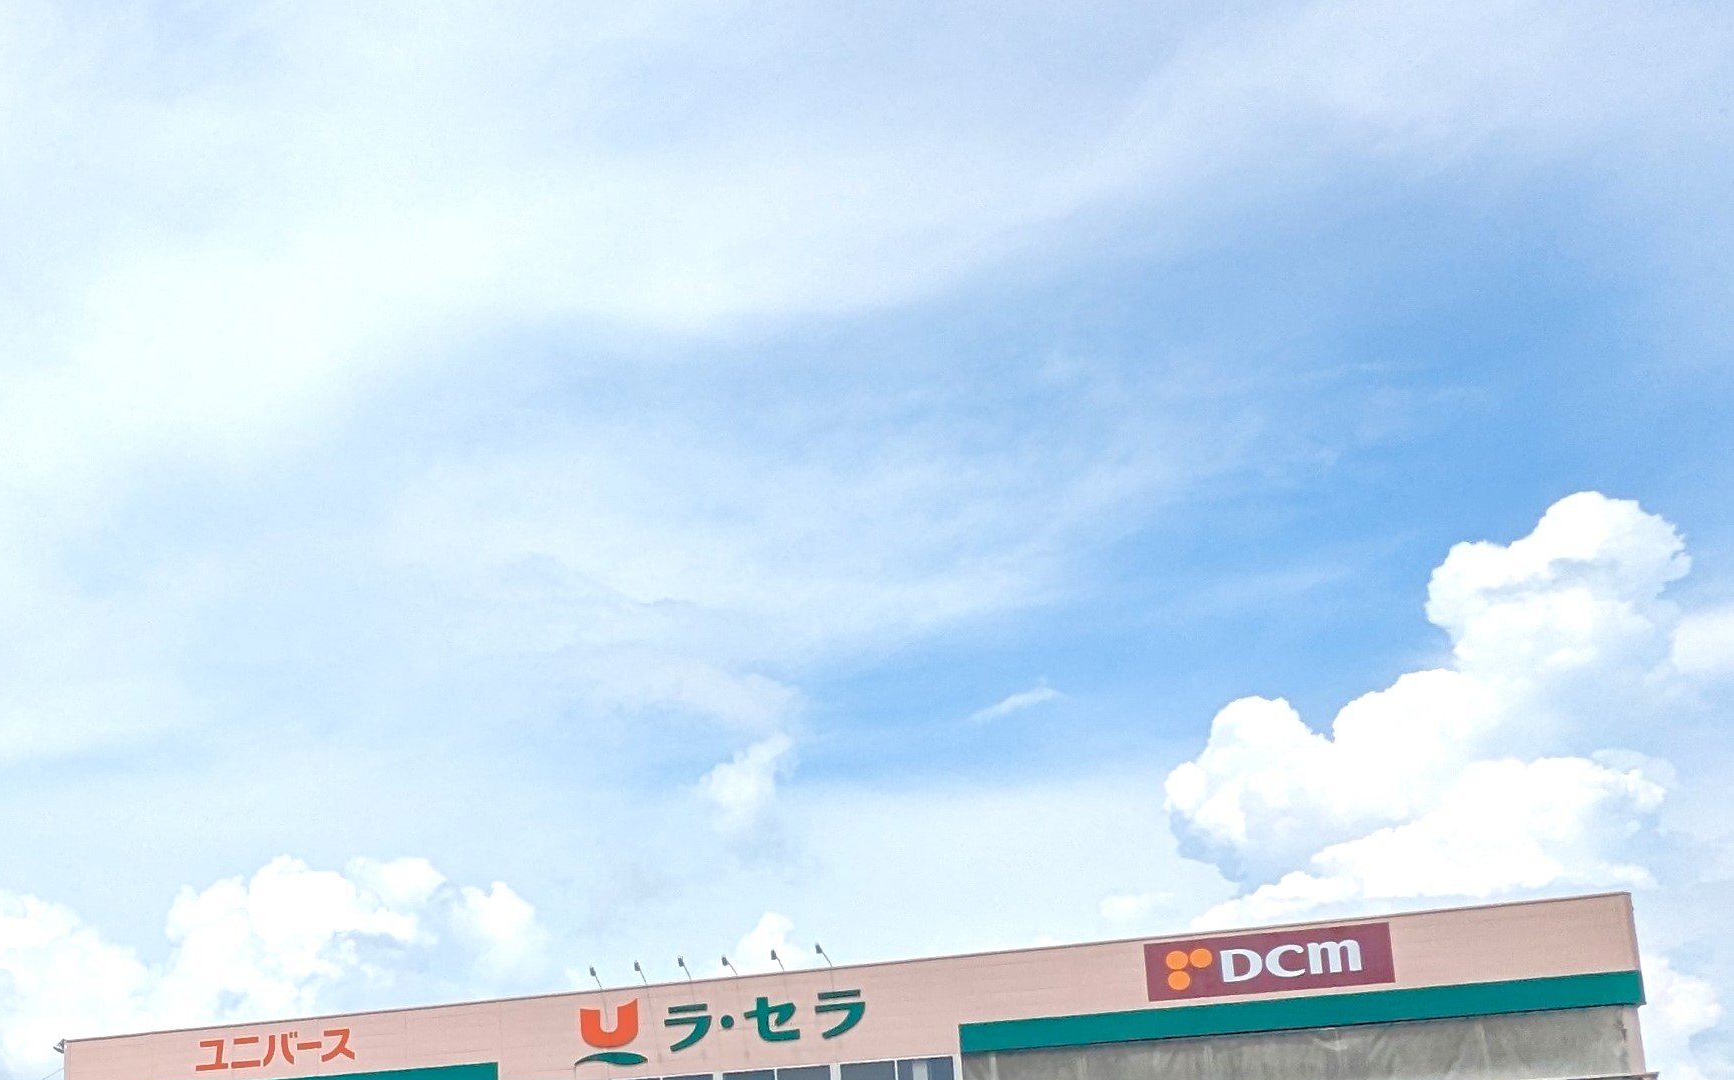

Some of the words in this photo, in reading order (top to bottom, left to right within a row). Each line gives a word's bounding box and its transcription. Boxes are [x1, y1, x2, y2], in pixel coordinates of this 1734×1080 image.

[664, 989, 865, 1052] ラ・セラ
[195, 1028, 355, 1071] ユニバース
